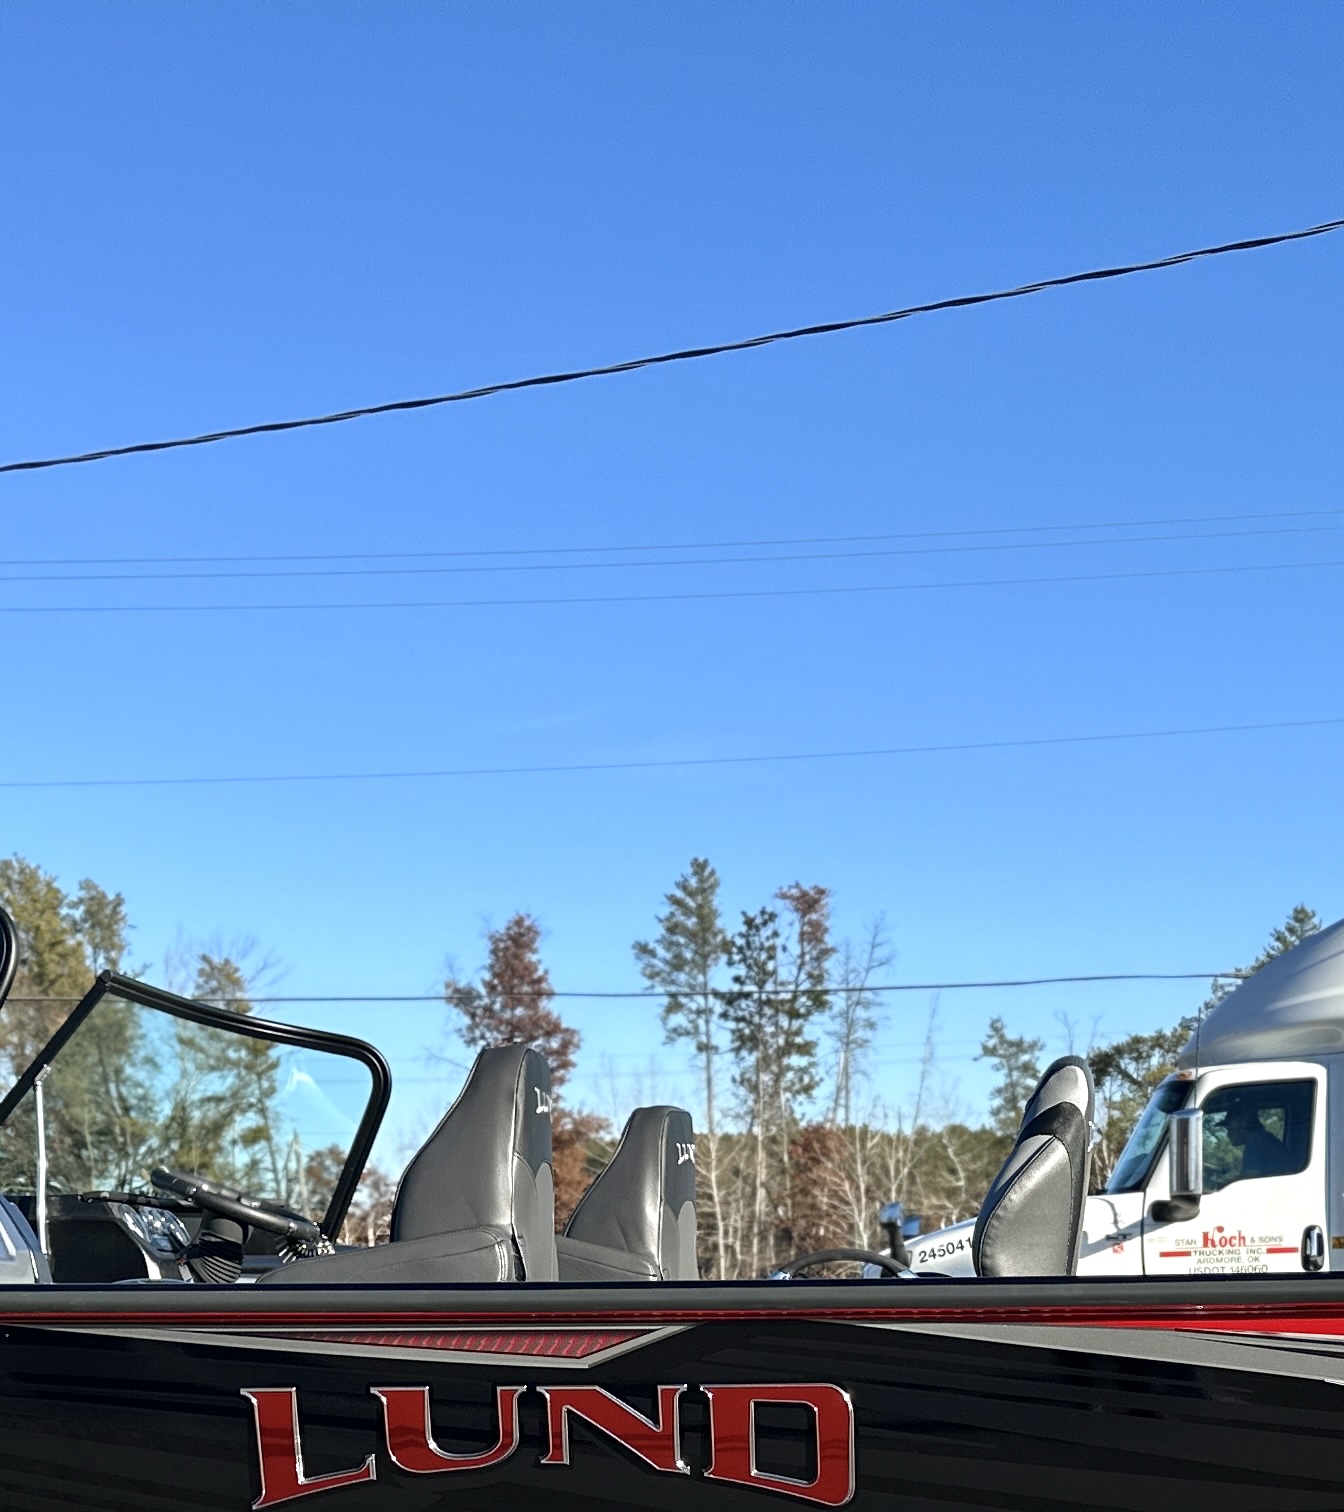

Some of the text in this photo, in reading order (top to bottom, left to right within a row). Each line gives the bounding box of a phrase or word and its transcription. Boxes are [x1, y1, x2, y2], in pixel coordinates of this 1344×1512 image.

[1174, 1238, 1197, 1247] STAN
[1201, 1225, 1247, 1249] Koch
[1258, 1235, 1284, 1244] SONS
[1192, 1248, 1242, 1257] TRUCKING
[1247, 1255, 1261, 1263] OK
[239, 1384, 856, 1511] LUND
